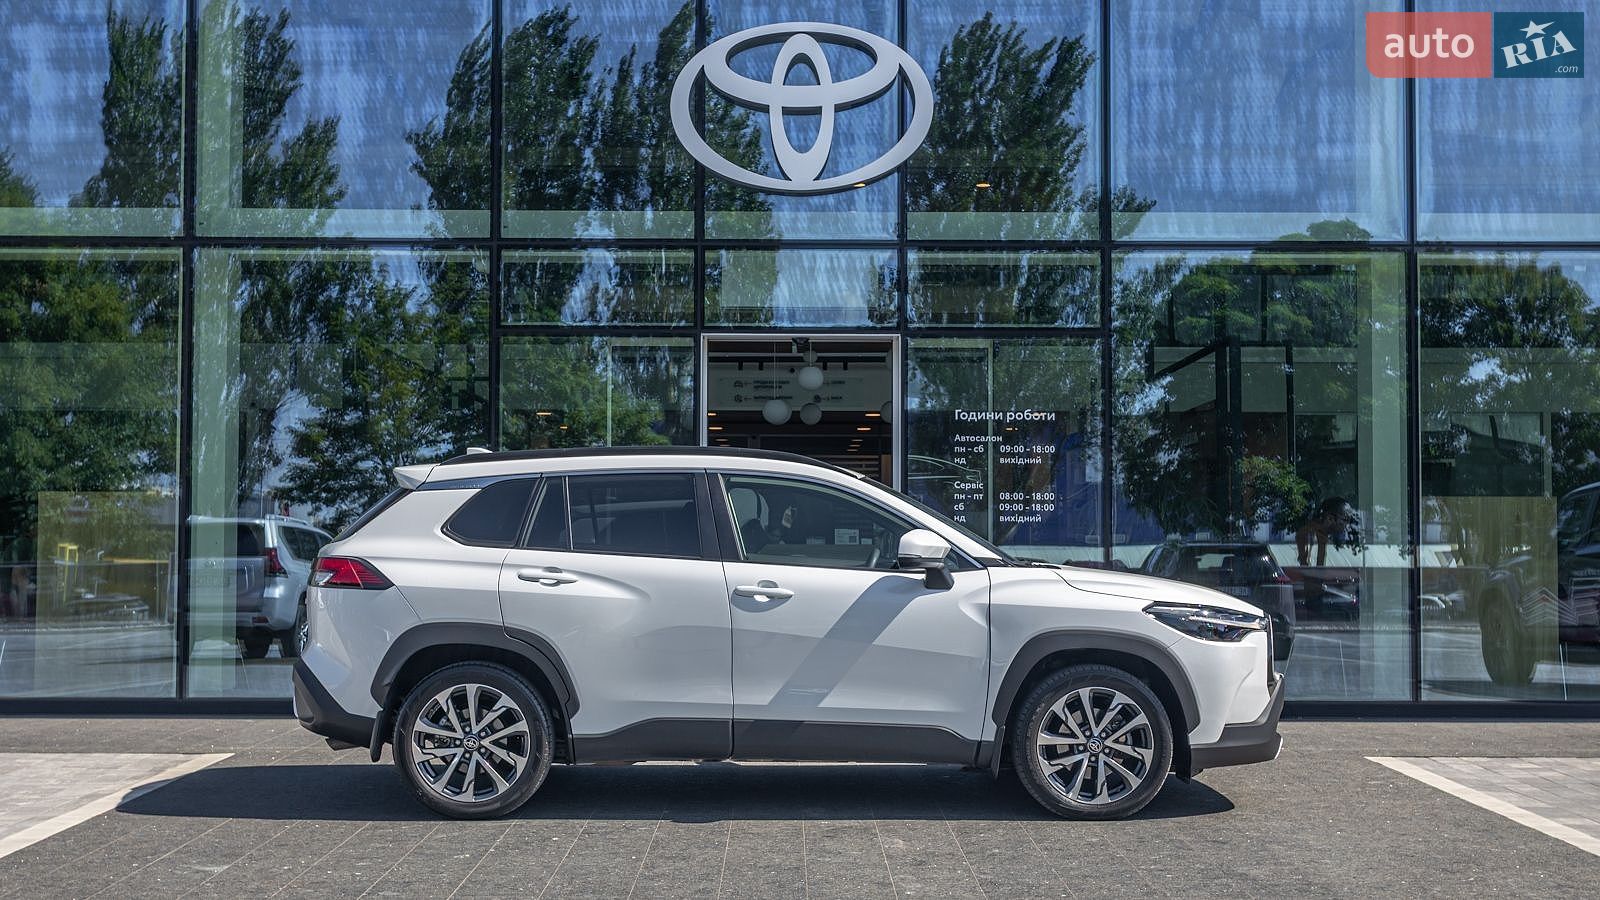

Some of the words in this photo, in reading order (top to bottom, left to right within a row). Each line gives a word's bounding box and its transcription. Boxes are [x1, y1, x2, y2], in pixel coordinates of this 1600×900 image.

[955, 409, 1003, 421] Години
[1006, 409, 1056, 422] роботи
[954, 434, 1003, 442] Автосалон
[973, 445, 984, 453] сб
[1000, 445, 1024, 453] 09:00
[1032, 445, 1056, 453] 18:00
[954, 456, 967, 464] нд
[999, 455, 1042, 464] вихідний
[954, 481, 984, 490] Сервіс
[954, 492, 966, 500] пн
[973, 492, 984, 500] пт
[999, 492, 1024, 500] 08:00
[1031, 492, 1055, 500] 18:00
[953, 503, 965, 511] сб
[999, 503, 1024, 511] 09:00
[1031, 503, 1055, 511] 18:00
[999, 513, 1042, 522] вихідний
